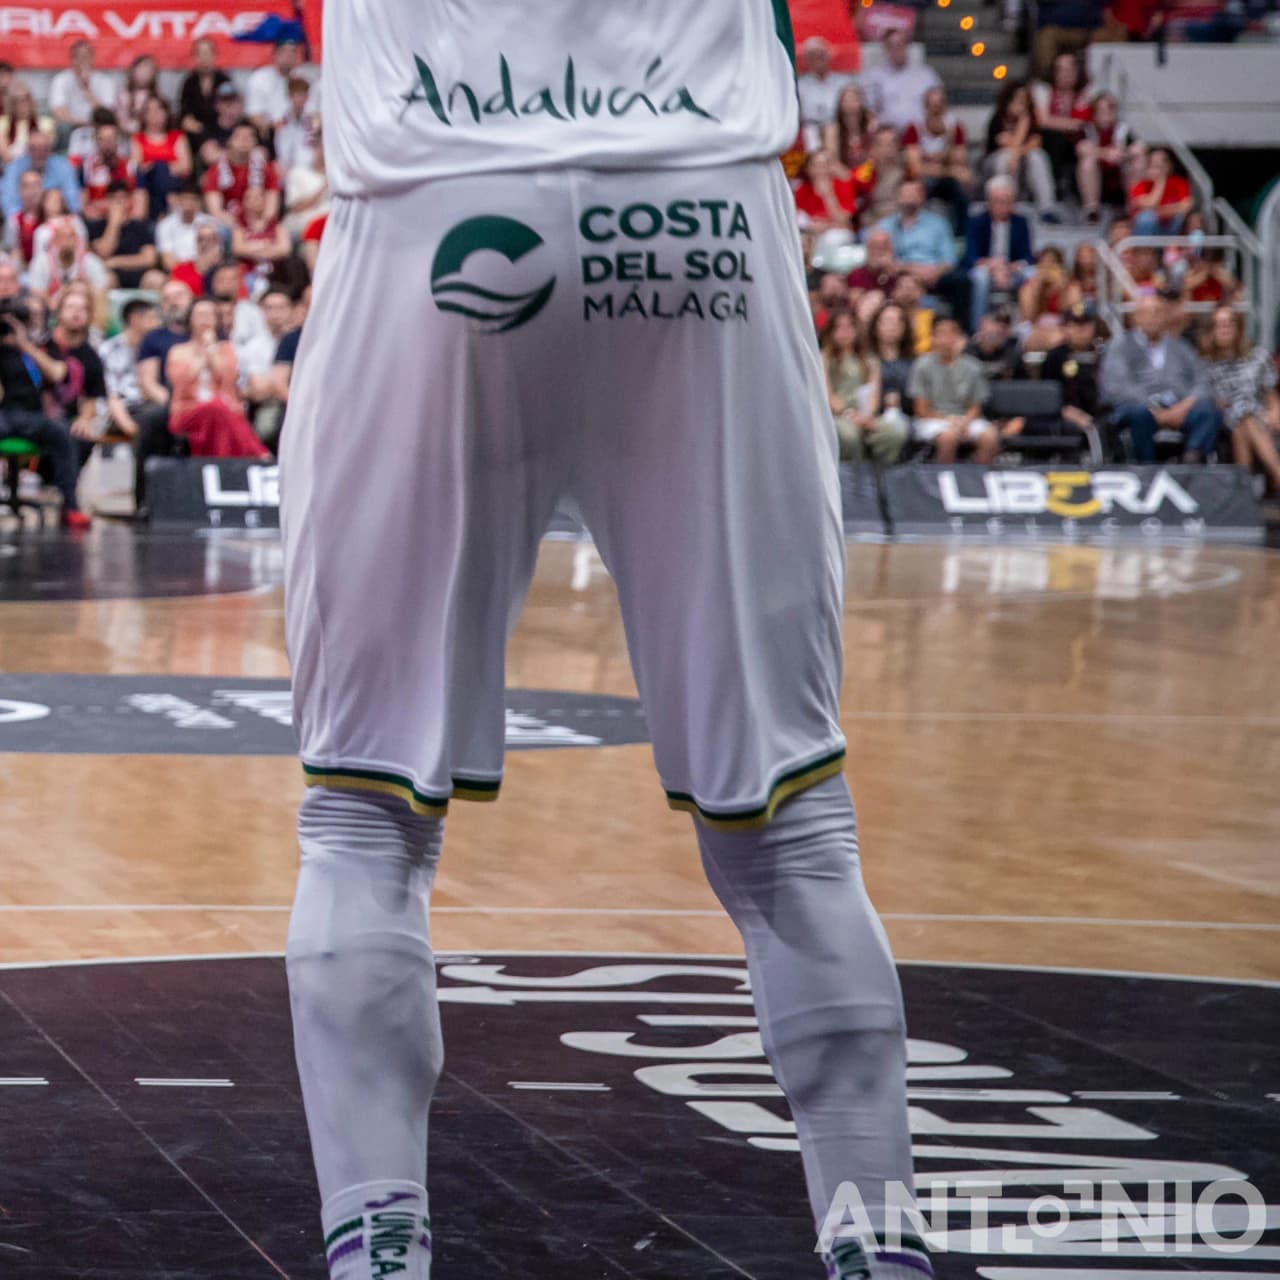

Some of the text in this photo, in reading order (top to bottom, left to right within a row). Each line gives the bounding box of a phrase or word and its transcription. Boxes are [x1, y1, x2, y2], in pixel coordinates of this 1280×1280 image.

[400, 51, 722, 128] Andalucía
[579, 199, 753, 244] COSTA
[582, 247, 755, 285] DEL SOL
[582, 283, 749, 323] MÁLAGA
[937, 470, 1199, 519] LIBERA
